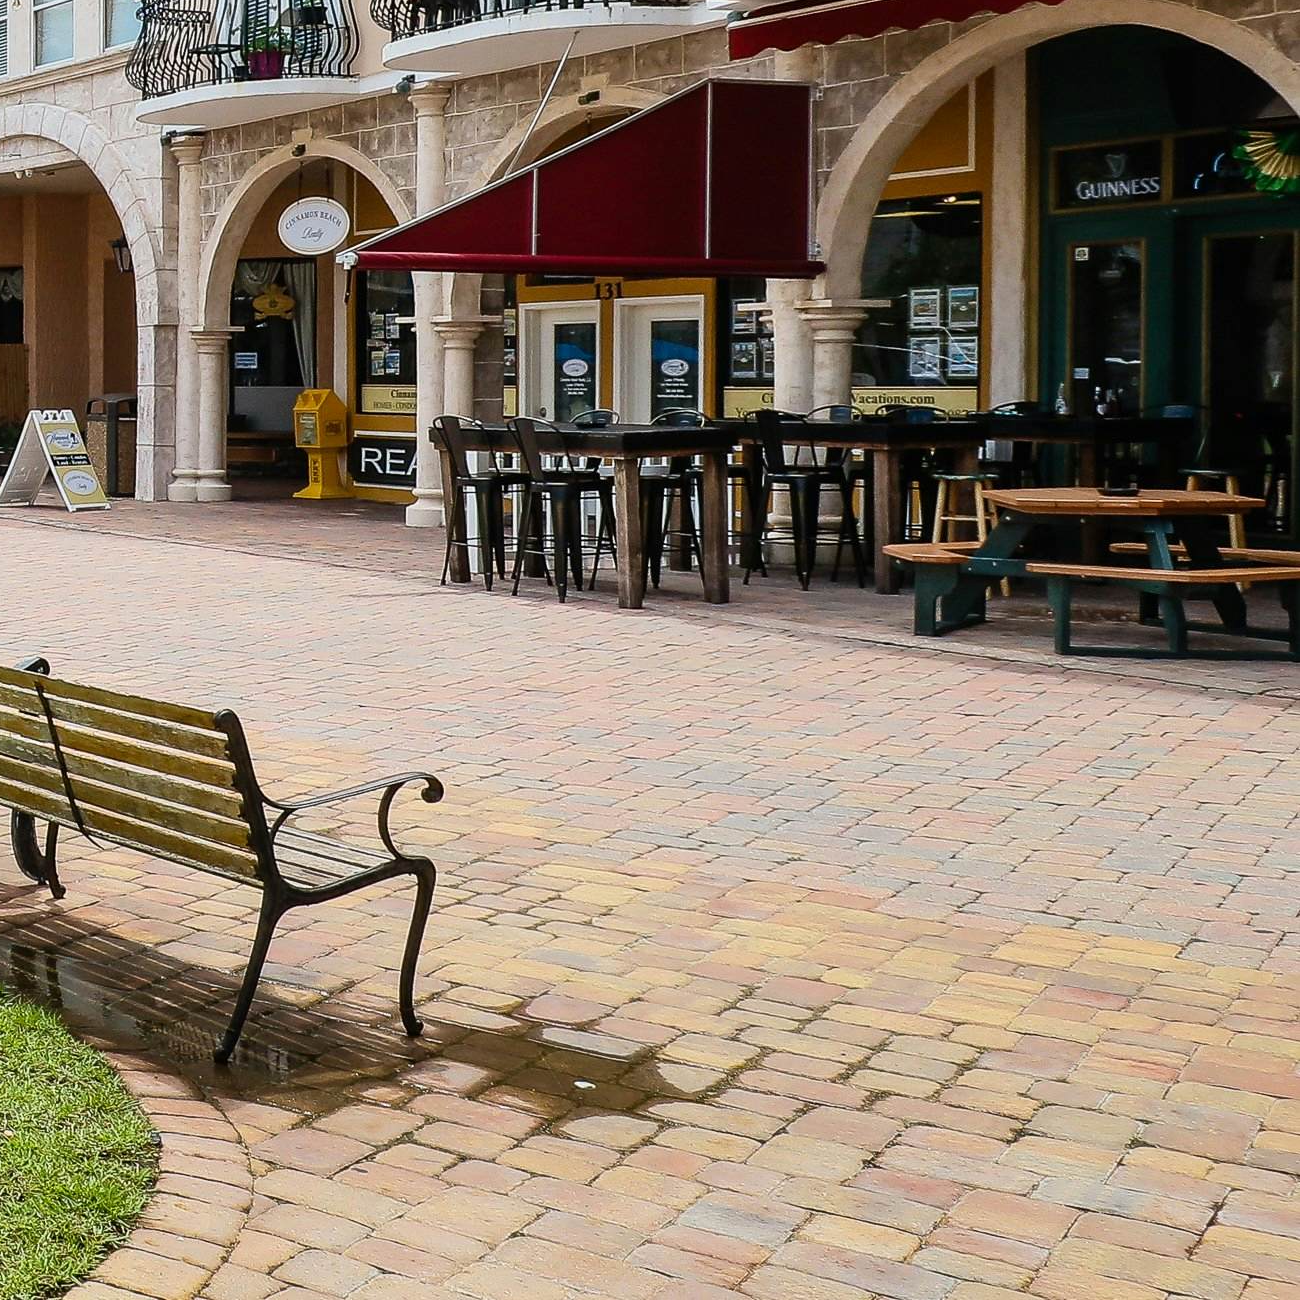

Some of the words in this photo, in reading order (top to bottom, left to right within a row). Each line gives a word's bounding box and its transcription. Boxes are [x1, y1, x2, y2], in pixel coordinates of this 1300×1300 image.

[1076, 176, 1160, 199] GUINNESS
[320, 211, 342, 228] BEACH
[594, 282, 623, 300] 131
